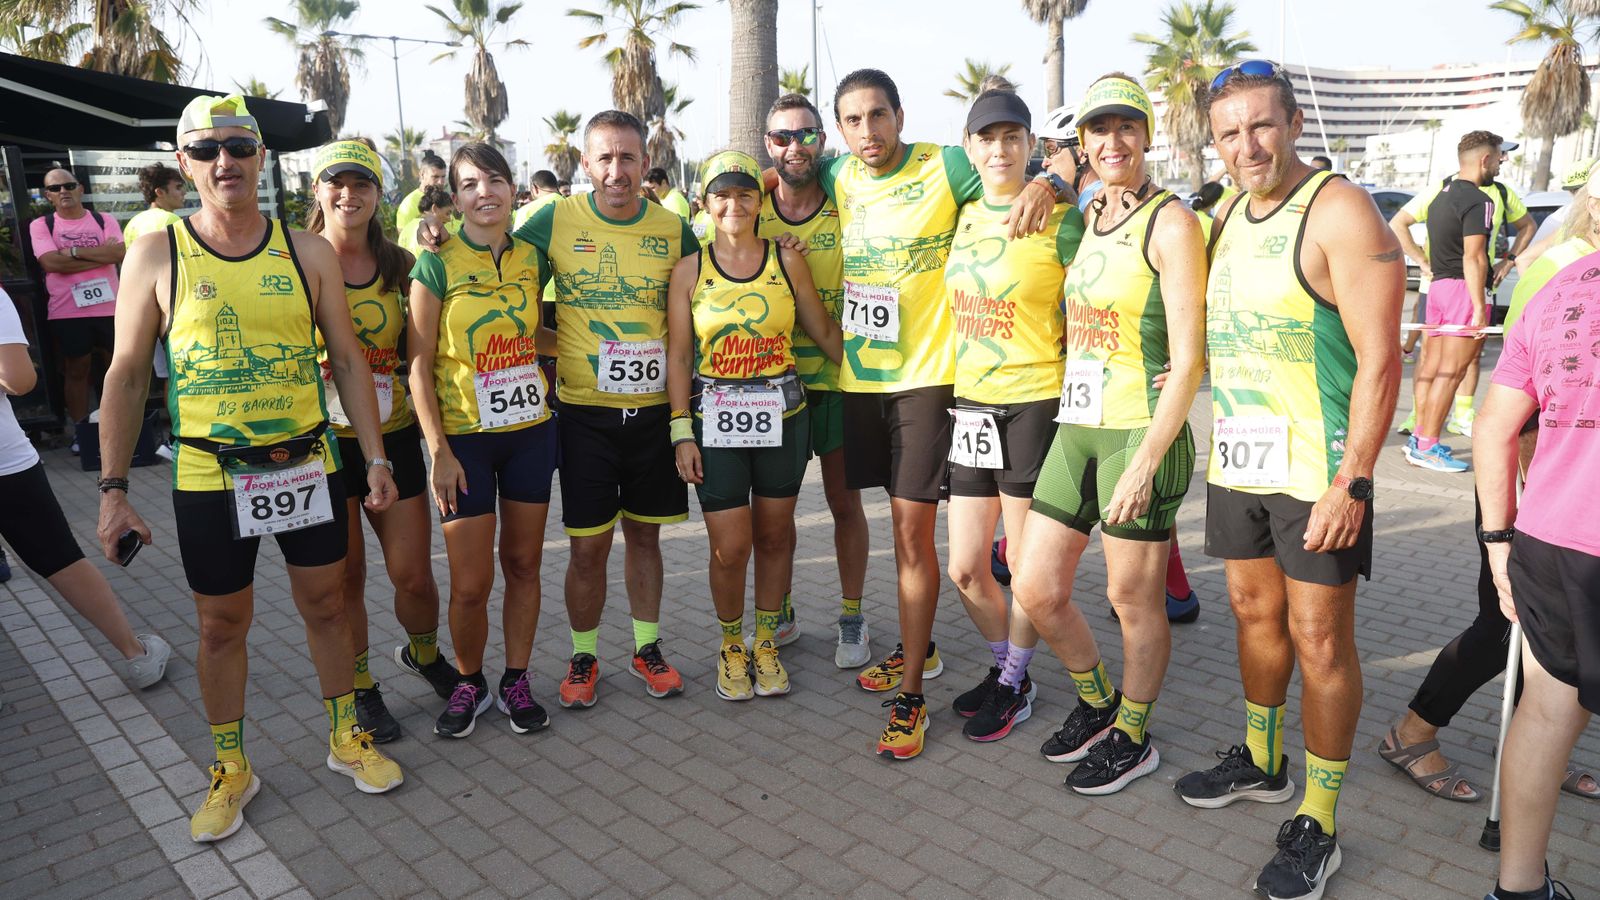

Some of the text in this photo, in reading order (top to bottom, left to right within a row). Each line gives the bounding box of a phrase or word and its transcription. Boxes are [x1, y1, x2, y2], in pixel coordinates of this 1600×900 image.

[83, 287, 102, 300] 80
[954, 289, 1016, 318] Mujeres
[848, 299, 890, 328] 719
[951, 307, 1015, 341] unners
[1067, 298, 1119, 329] Mujeres
[722, 335, 787, 357] Mujeres
[608, 359, 660, 382] 536
[712, 352, 785, 378] Runners
[489, 377, 507, 386] POR
[241, 395, 294, 413] BARRIOS
[490, 383, 540, 414] 548
[751, 399, 778, 407] MUJER
[717, 411, 772, 433] 898
[1249, 426, 1281, 435] MUJER
[252, 470, 323, 490] POR LA MUJER
[250, 484, 316, 520] 897
